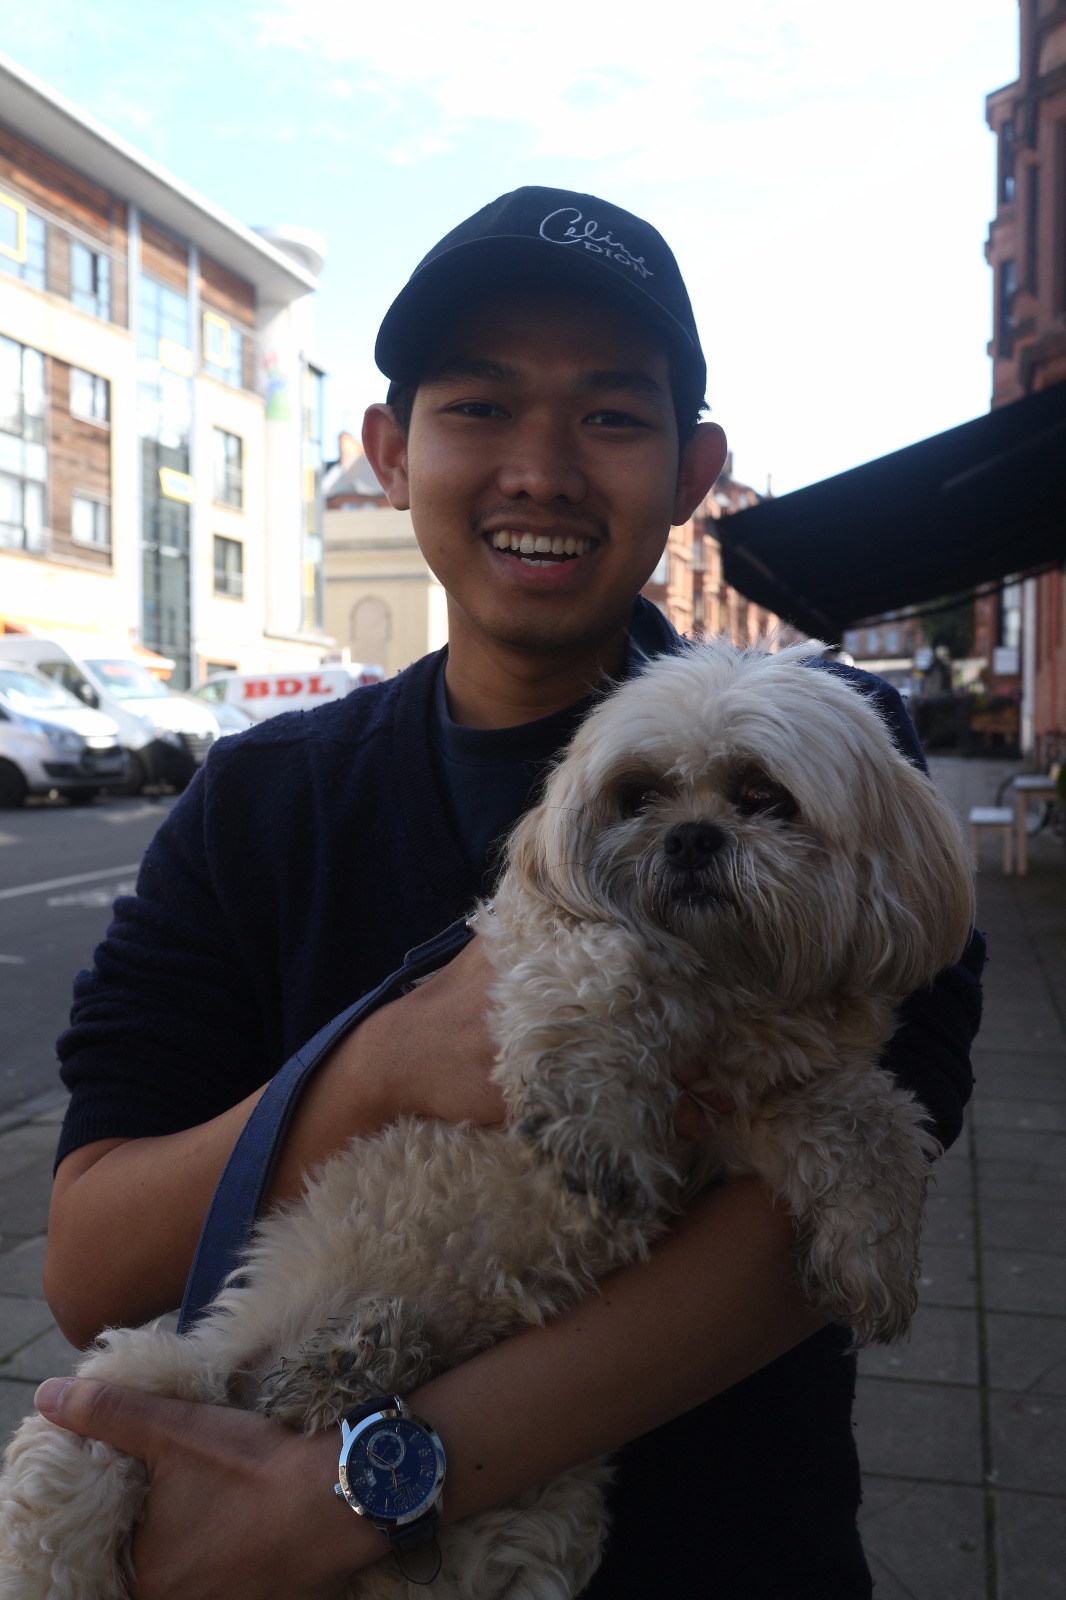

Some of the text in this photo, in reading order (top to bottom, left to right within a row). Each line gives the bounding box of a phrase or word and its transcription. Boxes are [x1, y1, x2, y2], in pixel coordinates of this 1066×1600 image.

[583, 241, 647, 278] DION
[244, 676, 333, 699] BDL
[391, 1484, 416, 1507] 12
